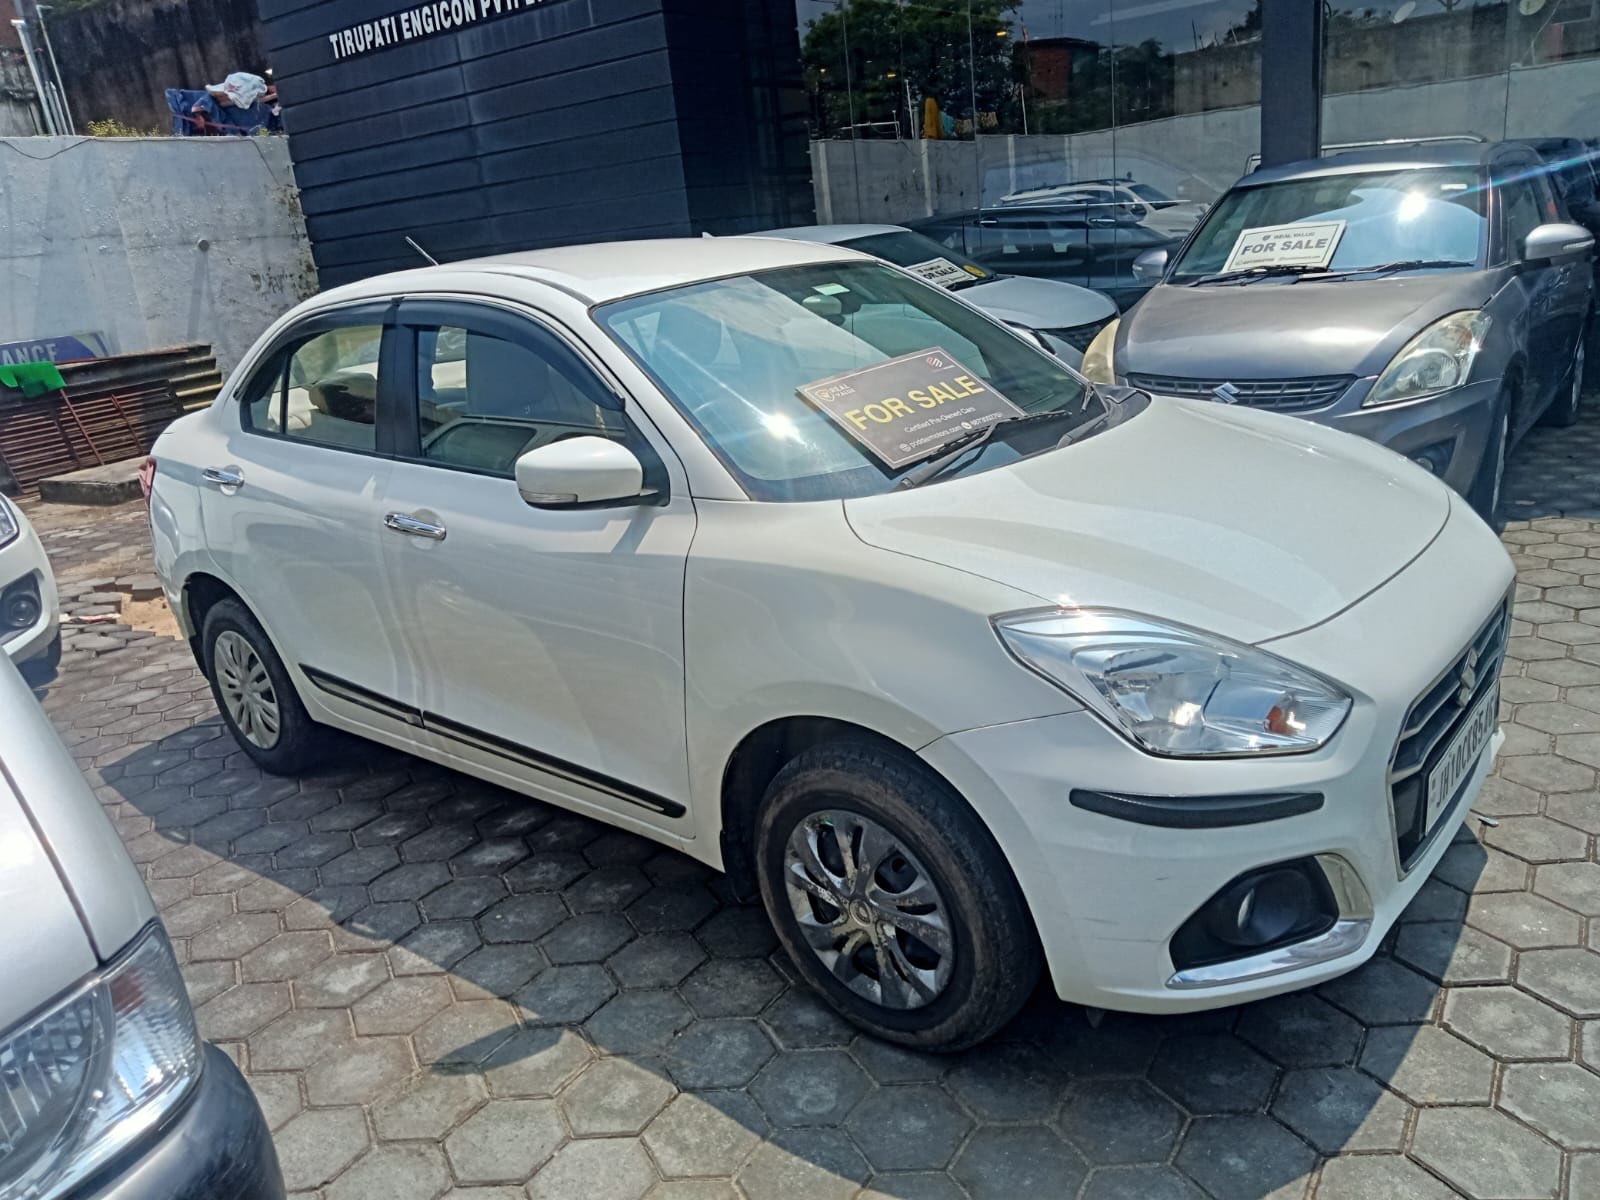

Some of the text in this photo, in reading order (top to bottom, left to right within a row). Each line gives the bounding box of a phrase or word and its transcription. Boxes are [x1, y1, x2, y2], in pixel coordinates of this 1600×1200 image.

[328, 16, 399, 59] TIRUPATI
[400, 0, 476, 40] ENGICON
[1241, 238, 1329, 256] FOR SALE
[935, 266, 958, 278] SALE
[843, 375, 985, 431] FOR SALE
